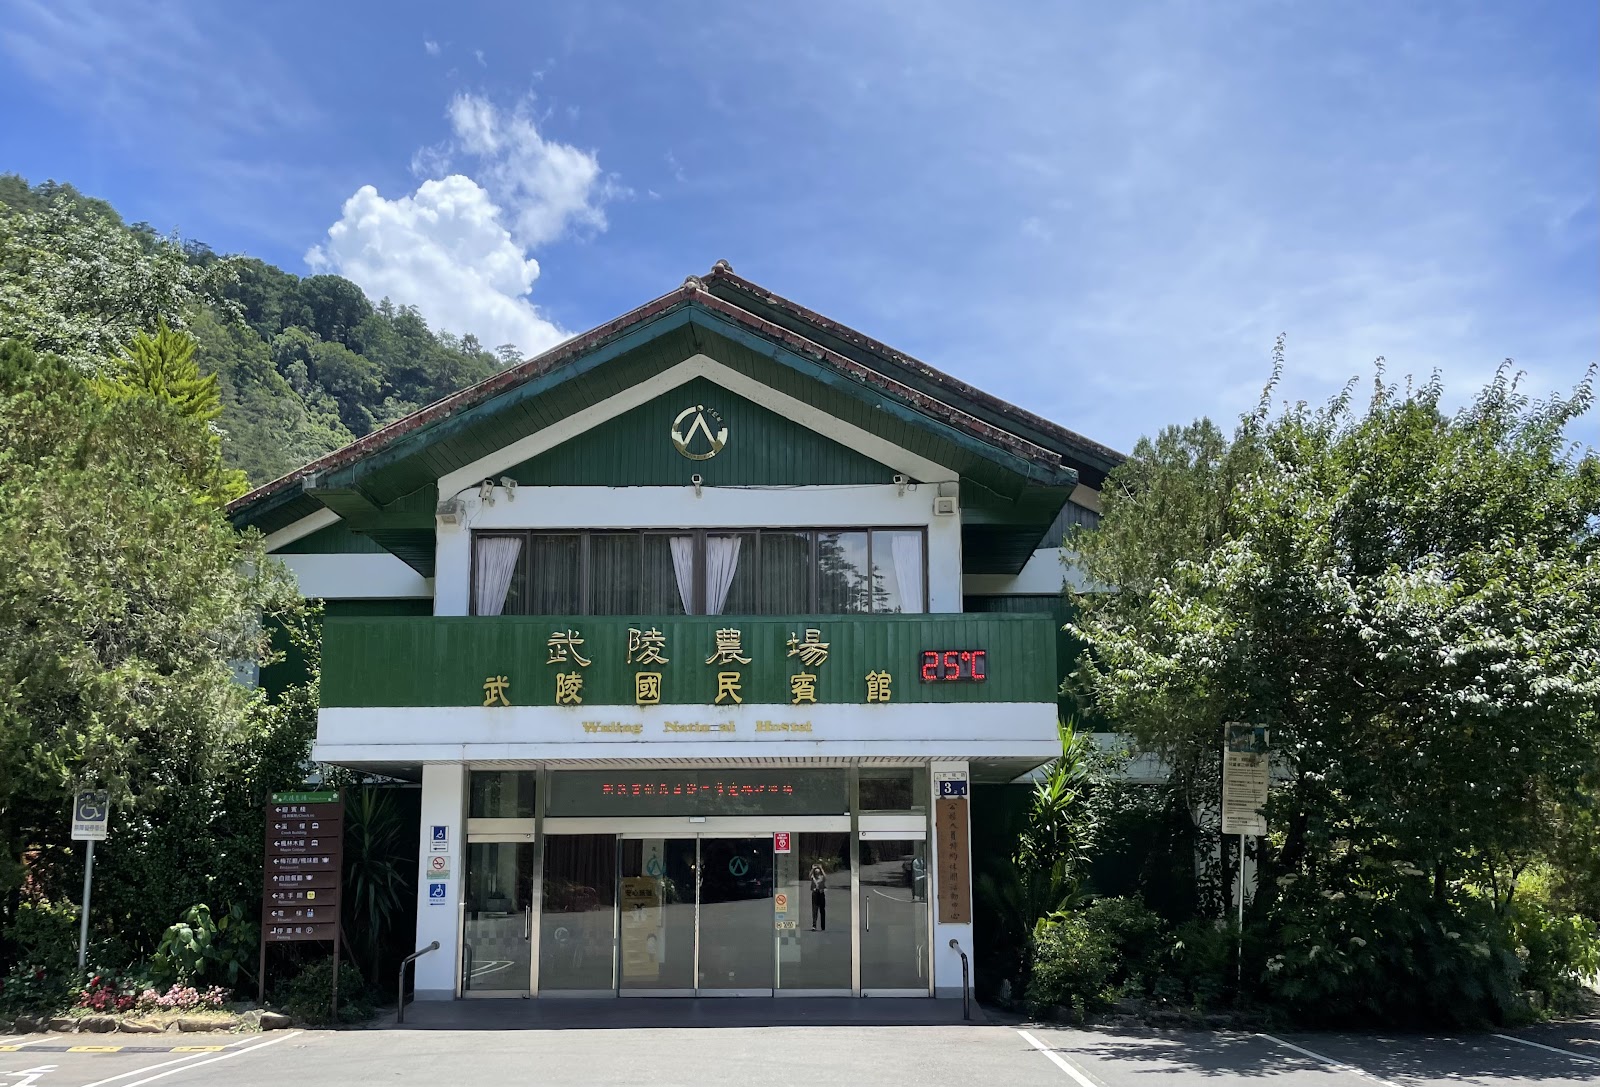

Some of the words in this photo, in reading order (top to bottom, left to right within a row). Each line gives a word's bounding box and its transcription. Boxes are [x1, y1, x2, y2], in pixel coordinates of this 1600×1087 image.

[546, 626, 830, 667] 武陵農場
[483, 670, 892, 707] 武陵國民賓館
[582, 721, 643, 734] Wuling
[755, 720, 812, 733] Hostel
